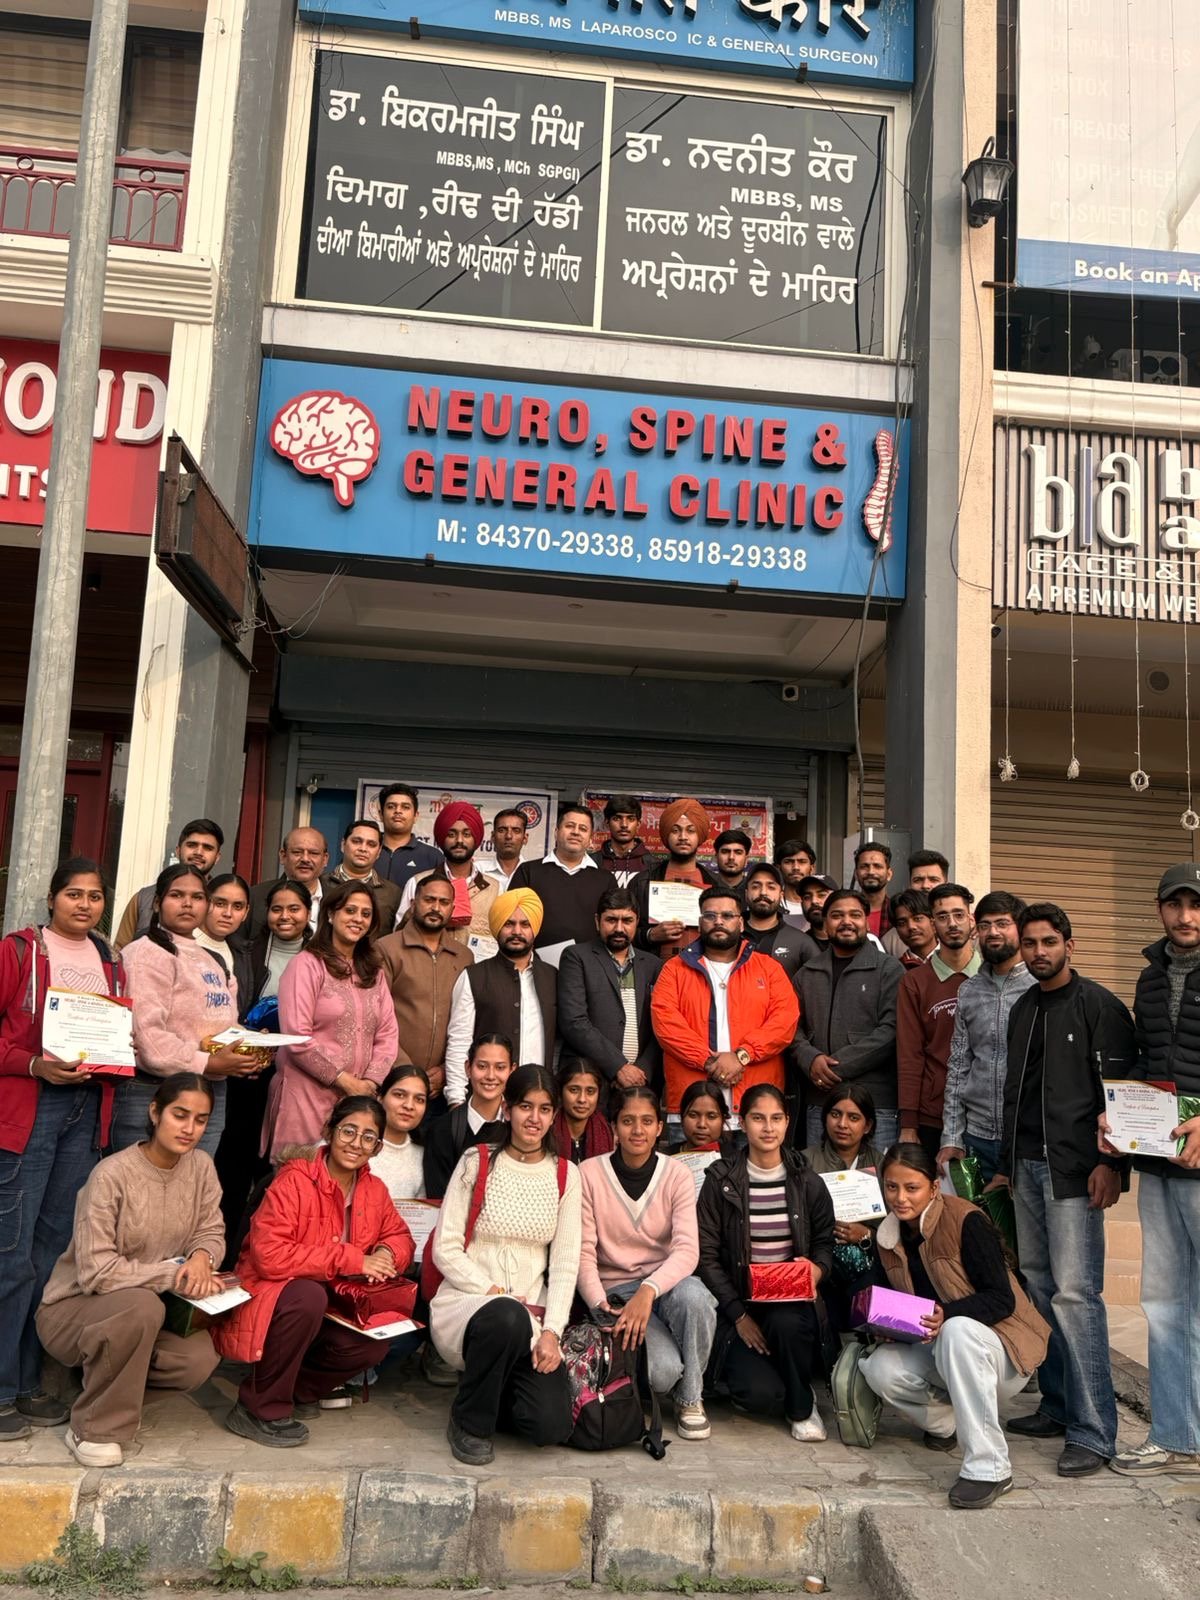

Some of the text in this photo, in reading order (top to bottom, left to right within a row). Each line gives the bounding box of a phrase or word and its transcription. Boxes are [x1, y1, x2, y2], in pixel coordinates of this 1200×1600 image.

[495, 10, 544, 28] MBBS,
[549, 16, 572, 30] MS
[707, 36, 717, 48] &
[722, 37, 794, 57] GENERAL
[799, 46, 879, 69] SURGEON)
[328, 85, 584, 150] ਡਾ. ਬਿਕਰਮਜੀਤ ਸਿੰਘ
[1050, 116, 1129, 142] THREADS
[504, 159, 531, 175] MCh
[538, 163, 580, 184] SGPGI)
[625, 131, 857, 183] ਡਾ. ਨਵਨੀਤ ਕੌਰ
[326, 165, 408, 209] ਦਿਮਾਗ
[492, 187, 523, 223] ਦੀ
[533, 192, 583, 231] ਹੱਡੀ
[731, 187, 843, 212] MBBS, MS
[357, 220, 422, 265] ਬਿਮਾਰੀਆਂ
[426, 230, 453, 269] ਅਤੇ
[523, 239, 536, 278] ਦੇ
[540, 244, 582, 282] ਮਾਹਿਰ
[625, 205, 855, 253] ਜਨਰਲ ਅਤੇ ਦੂਰਬੀਨ ਵਾਲੇ
[749, 259, 770, 297] ਦੇ
[782, 264, 857, 305] ਮਾਹਿਰ
[1075, 260, 1133, 280] Book
[1141, 270, 1168, 284] an
[407, 385, 847, 470] NEURO, SPINE &
[403, 450, 844, 530] GENERAL CLINIC
[437, 518, 807, 572] M: 84370-29338, 85918-29338
[1035, 553, 1180, 580] FACE &
[1026, 584, 1042, 601] A
[1050, 586, 1156, 609] PREMIUM
